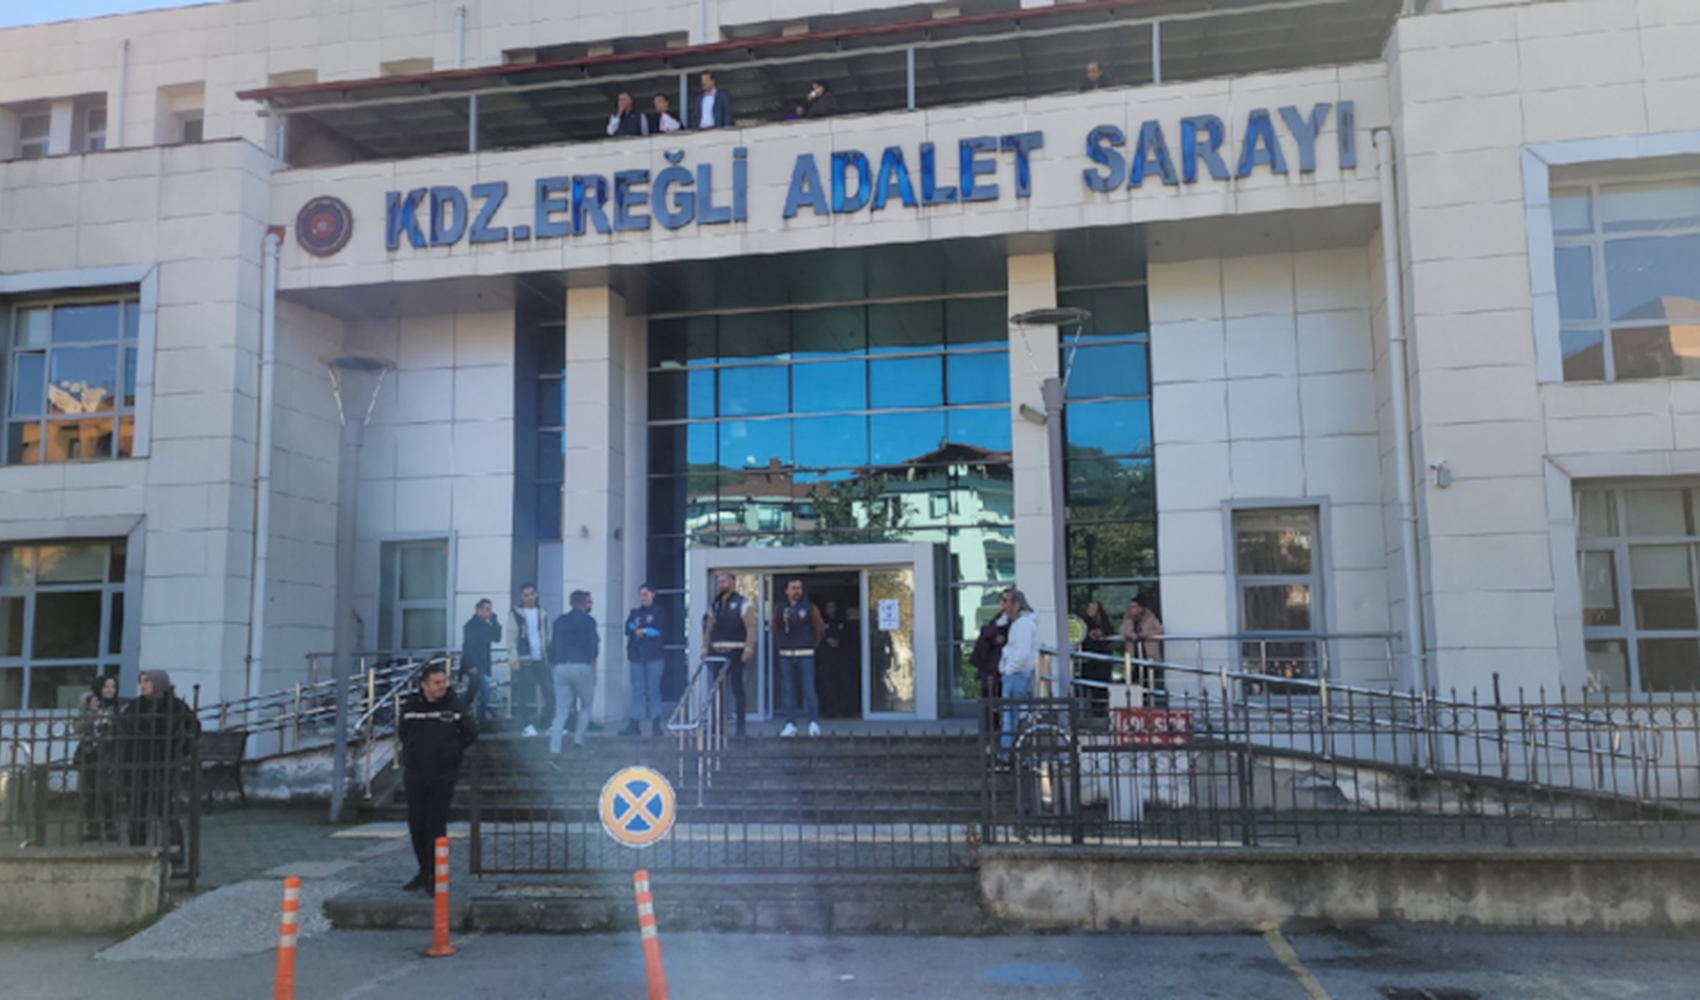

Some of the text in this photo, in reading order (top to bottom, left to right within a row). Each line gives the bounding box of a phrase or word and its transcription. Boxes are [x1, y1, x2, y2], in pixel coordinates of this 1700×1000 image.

[386, 101, 1356, 250] KDZ.EREĞLİ ADALET SARAYI
